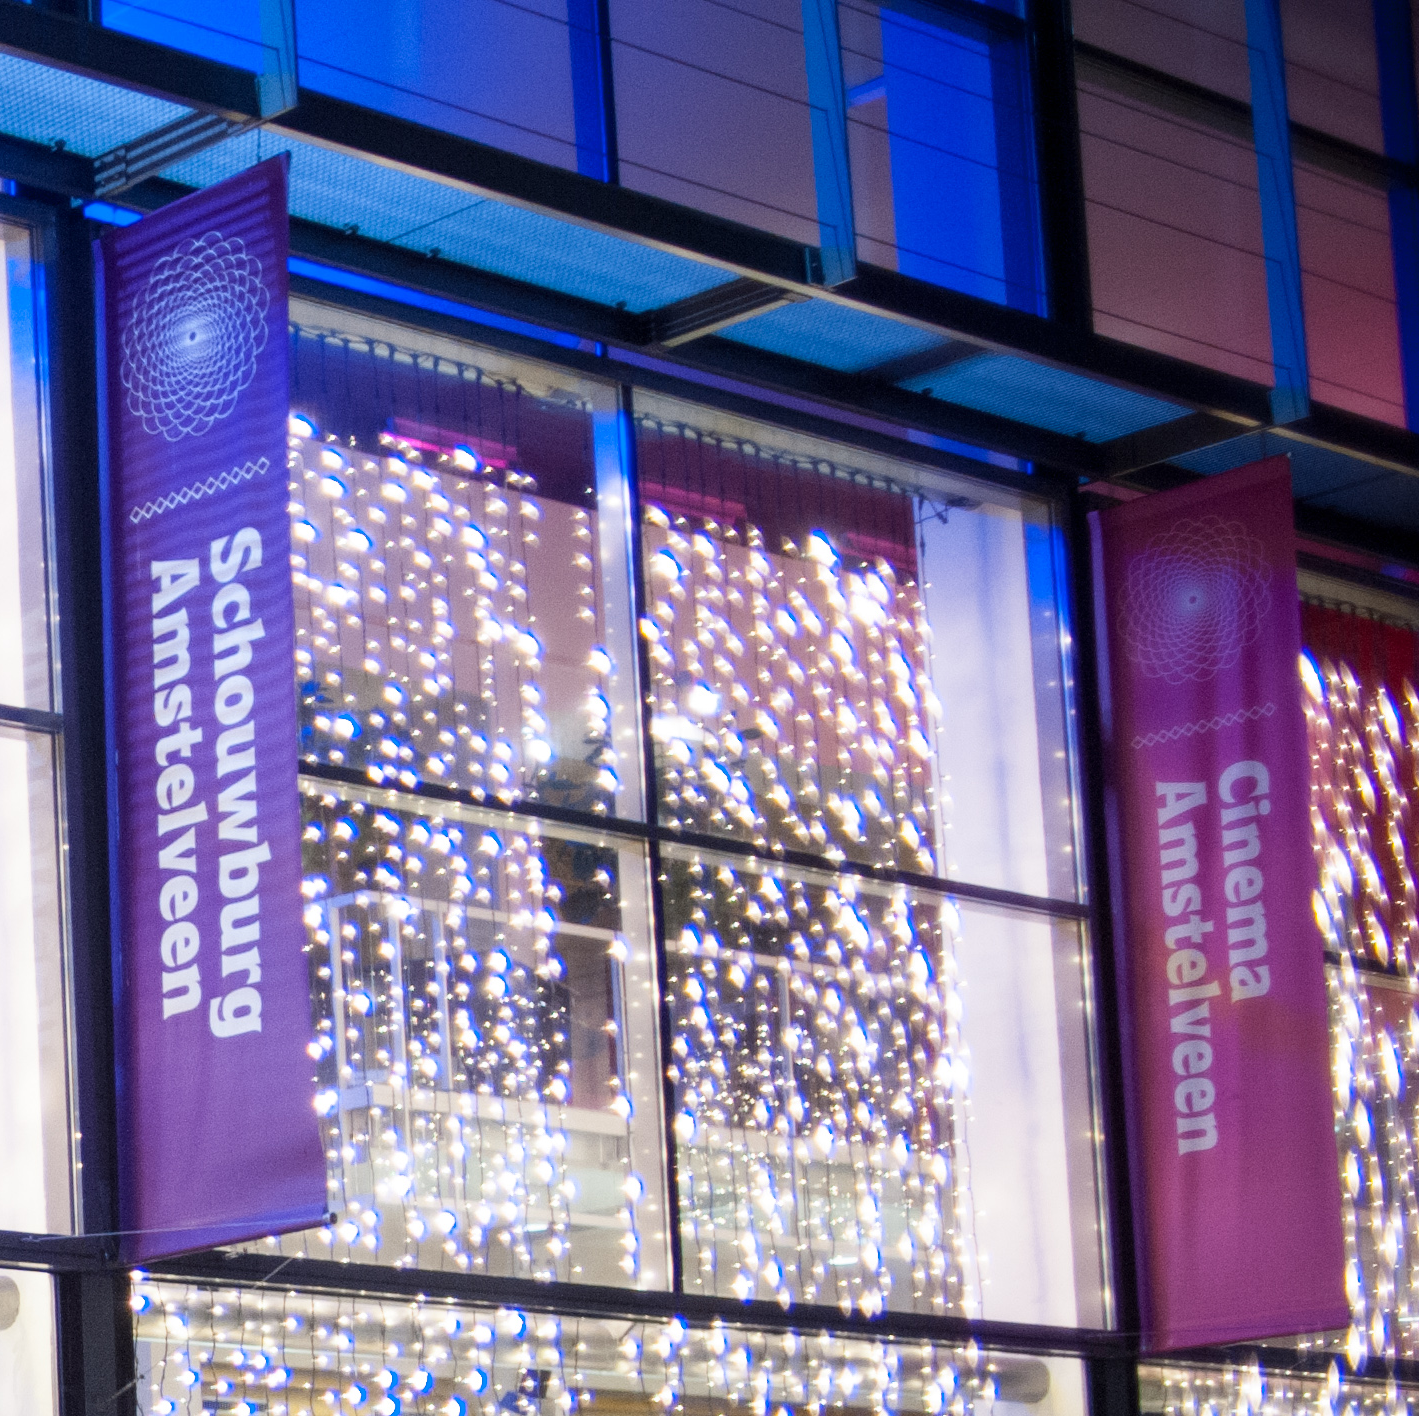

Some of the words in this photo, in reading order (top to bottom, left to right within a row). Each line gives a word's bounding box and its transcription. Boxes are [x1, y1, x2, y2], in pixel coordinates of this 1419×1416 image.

[150, 557, 208, 1021] Amstelveen
[209, 526, 272, 1038] Schouwburg
[1156, 781, 1221, 1156] Amstelveen
[1219, 760, 1272, 1004] Cinema
